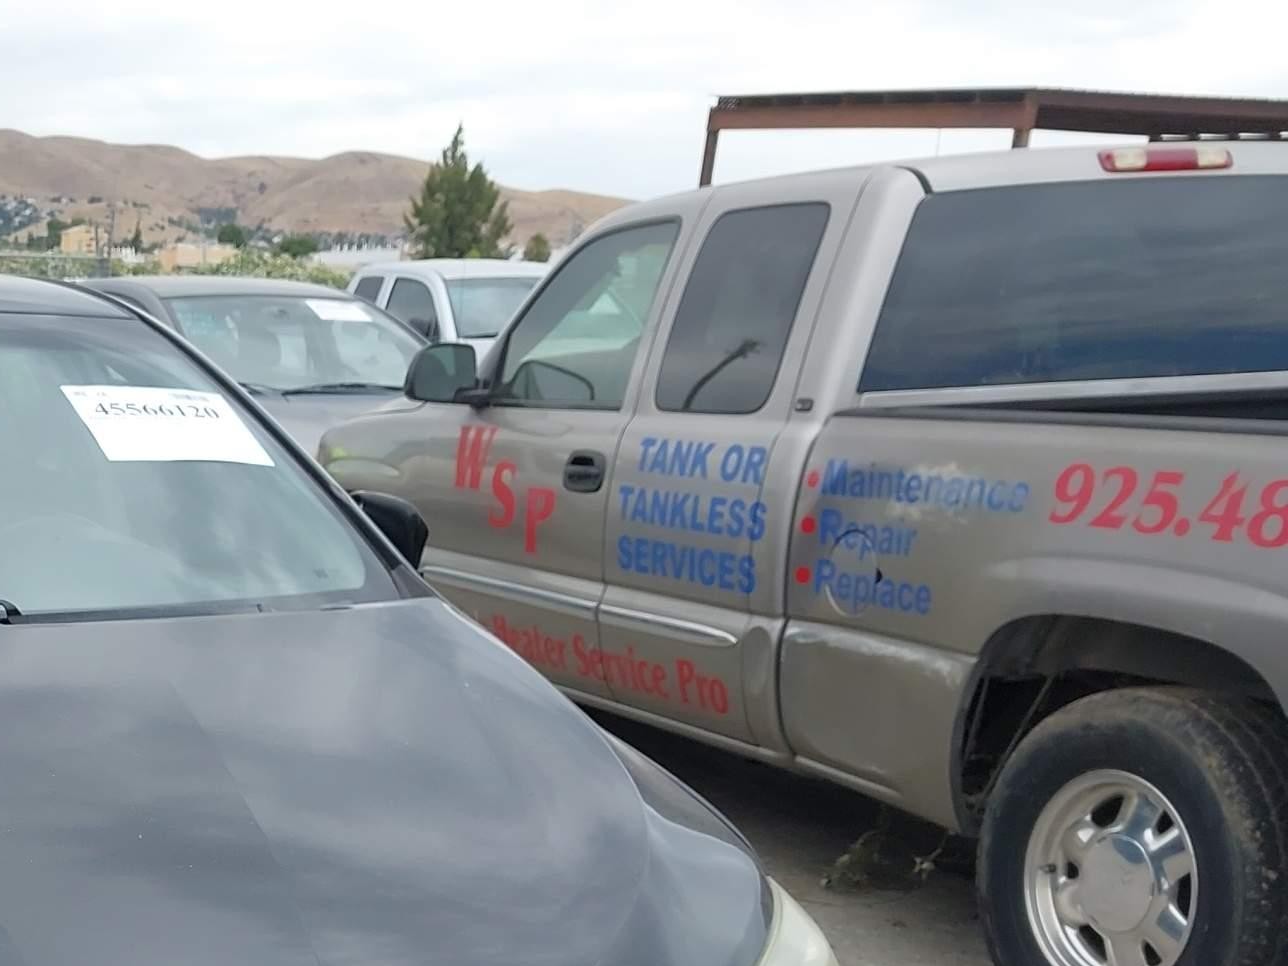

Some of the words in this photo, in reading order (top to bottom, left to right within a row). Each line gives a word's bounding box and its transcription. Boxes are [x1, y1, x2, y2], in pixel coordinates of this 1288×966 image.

[94, 402, 221, 420] 45566120
[638, 437, 718, 479] TANK
[720, 444, 767, 485] OR
[822, 459, 1030, 513] Maintenance
[619, 485, 767, 541] TANKLESS
[819, 508, 918, 560] Repair
[1048, 463, 1288, 549] 925.48
[618, 535, 756, 594] SERVICES
[815, 558, 932, 616] Replace
[573, 634, 668, 698] Service
[675, 657, 729, 714] Pro
